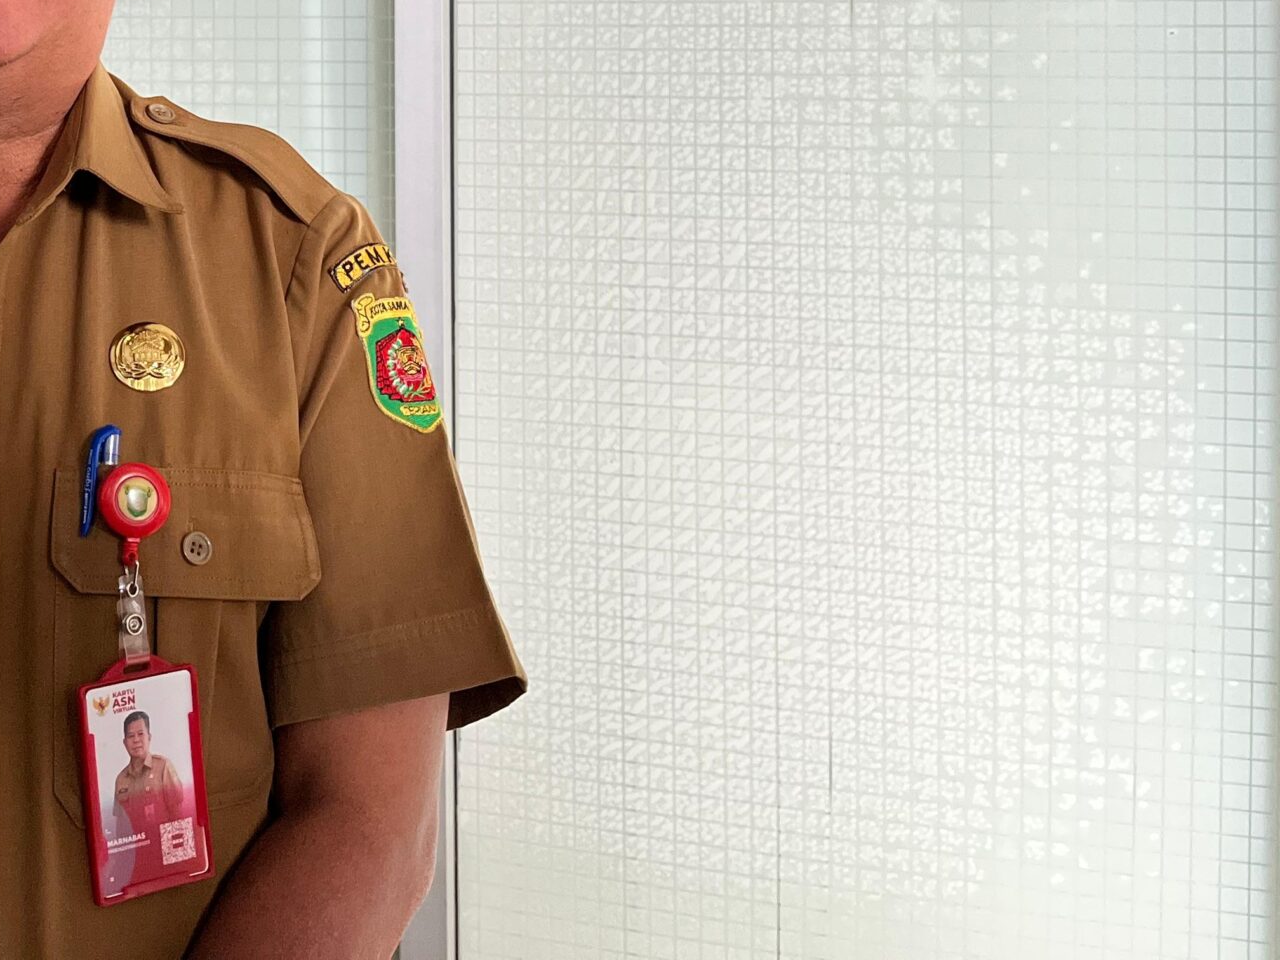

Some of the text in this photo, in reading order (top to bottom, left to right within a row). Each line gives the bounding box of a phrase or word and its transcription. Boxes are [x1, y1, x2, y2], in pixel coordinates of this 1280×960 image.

[112, 688, 135, 698] KARTU
[113, 695, 136, 708] ASN
[107, 832, 146, 848] MARNABAS
